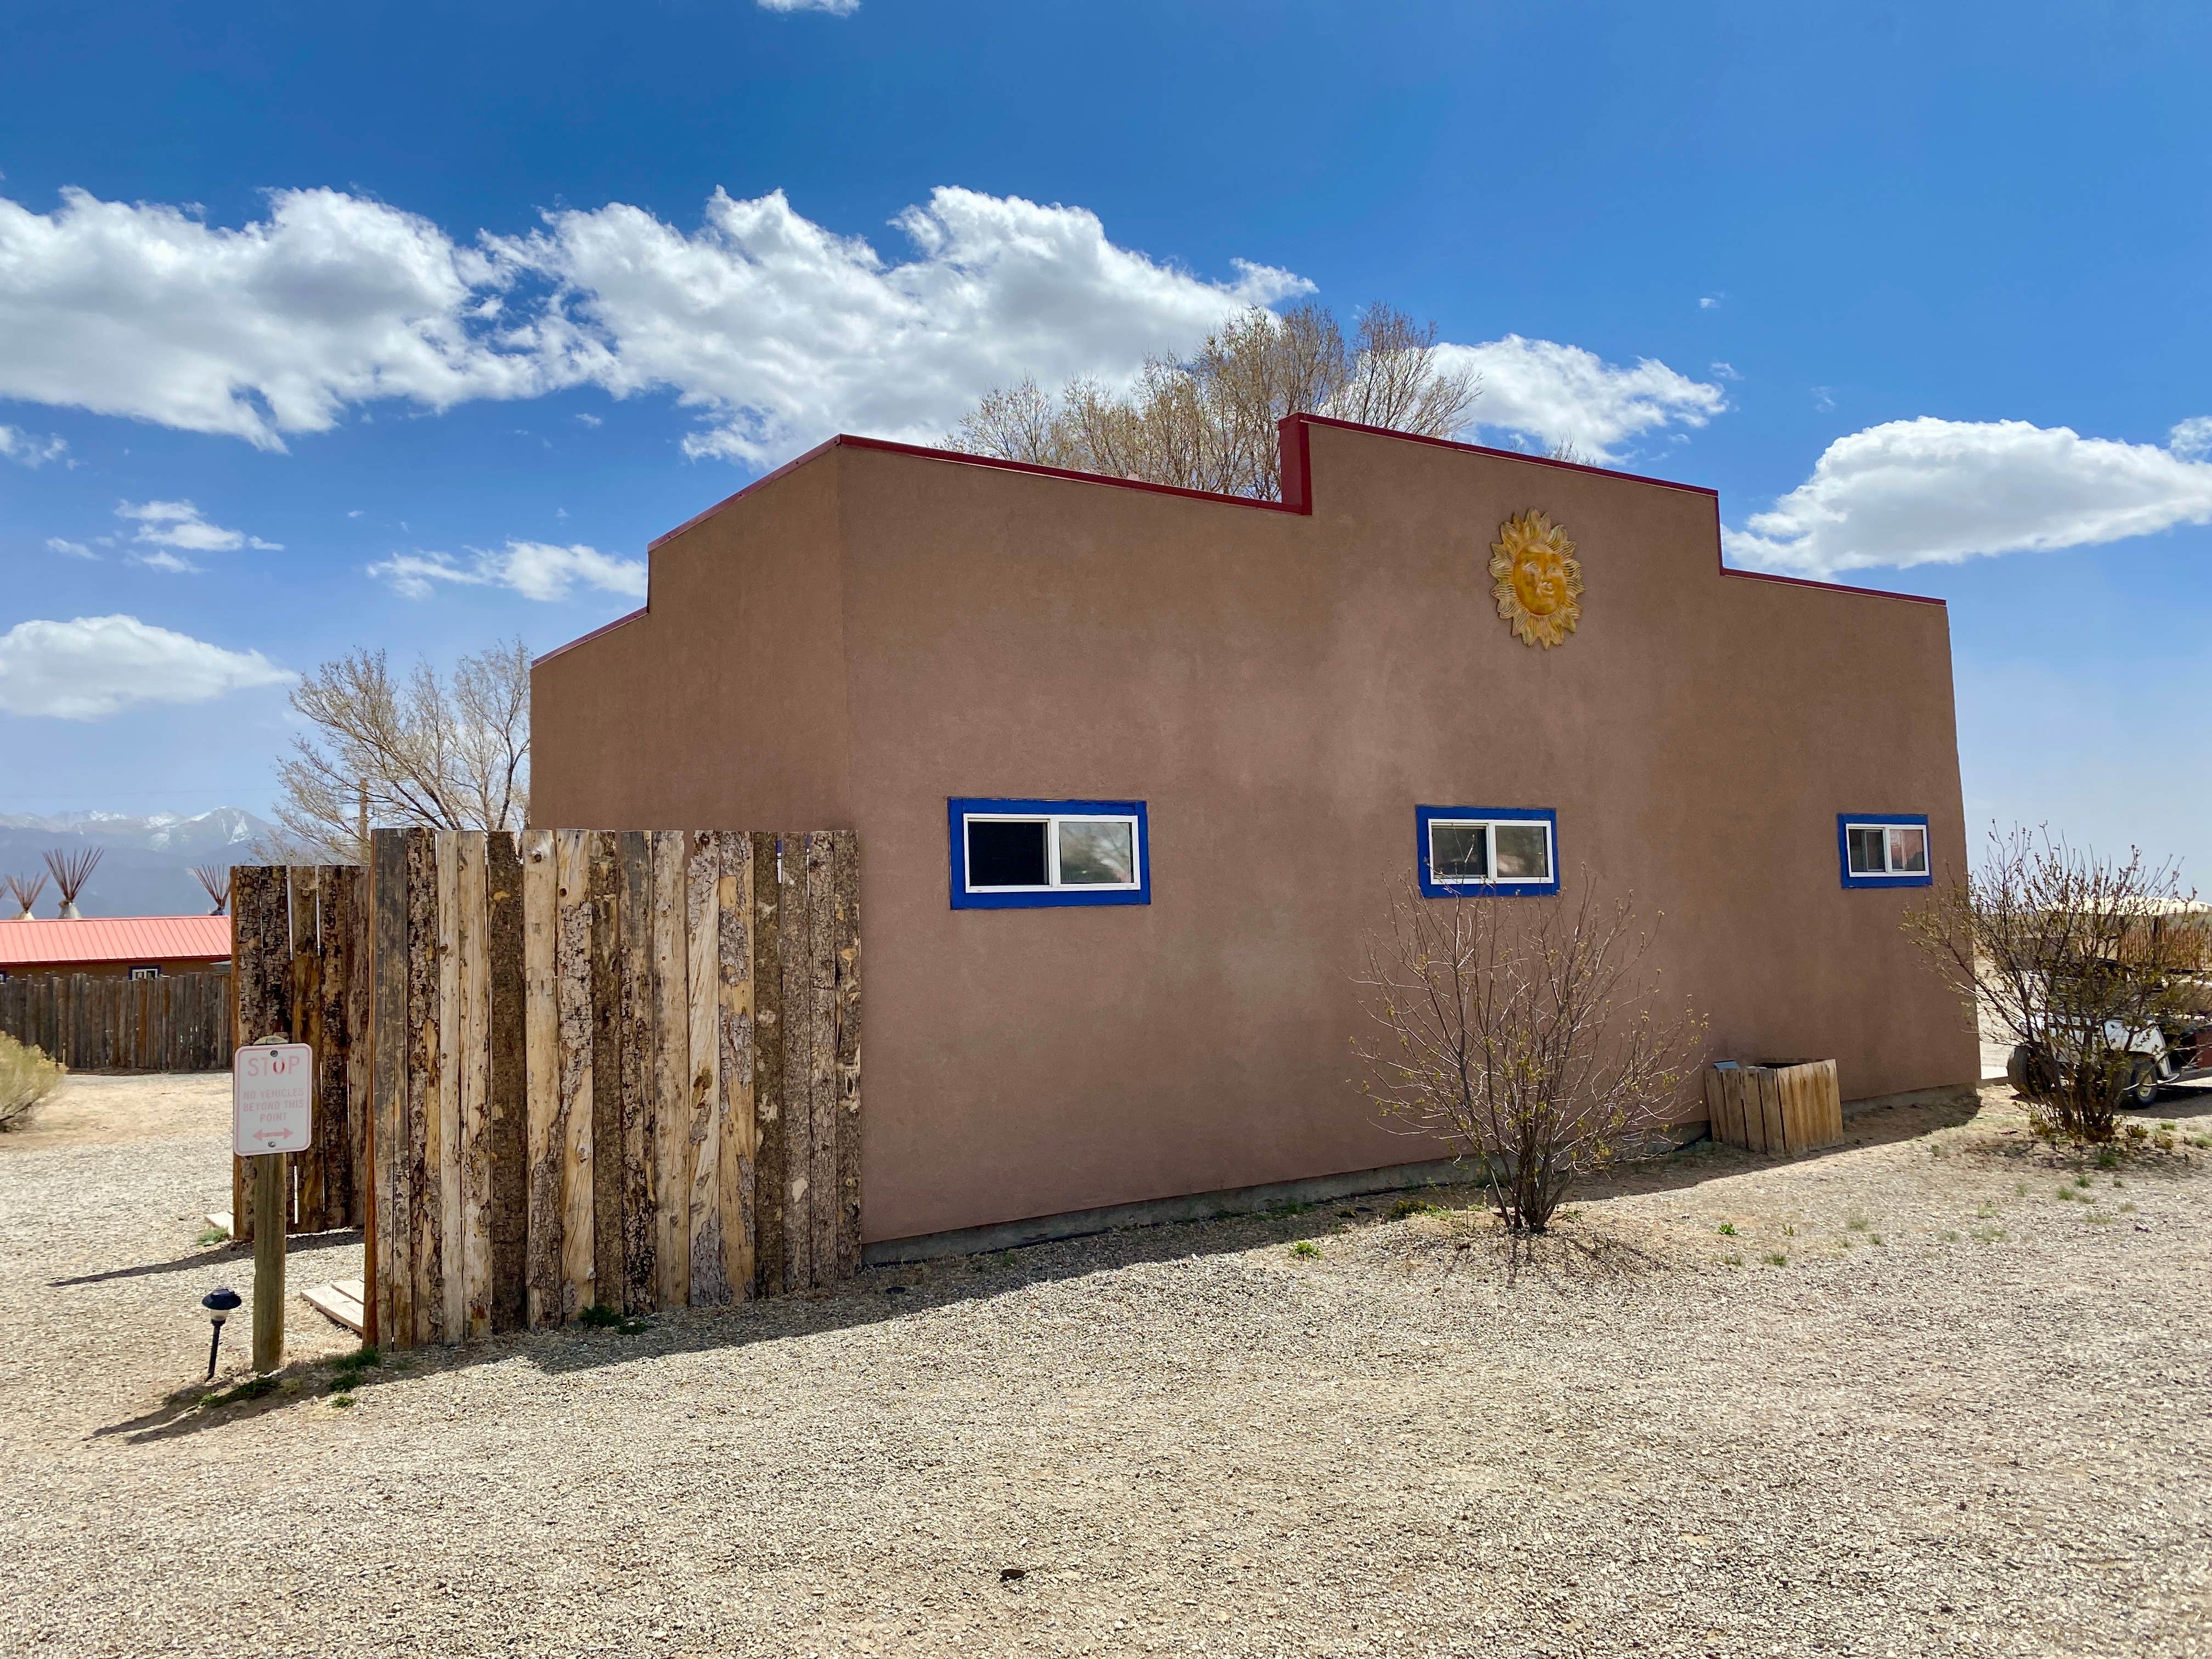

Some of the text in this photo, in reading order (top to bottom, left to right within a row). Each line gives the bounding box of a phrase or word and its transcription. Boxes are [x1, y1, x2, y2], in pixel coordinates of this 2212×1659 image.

[247, 1055, 300, 1077] STOP
[243, 1087, 303, 1099] NO VEHICLES
[243, 1099, 304, 1111] BEYOND THIS
[259, 1113, 287, 1123] POINT
